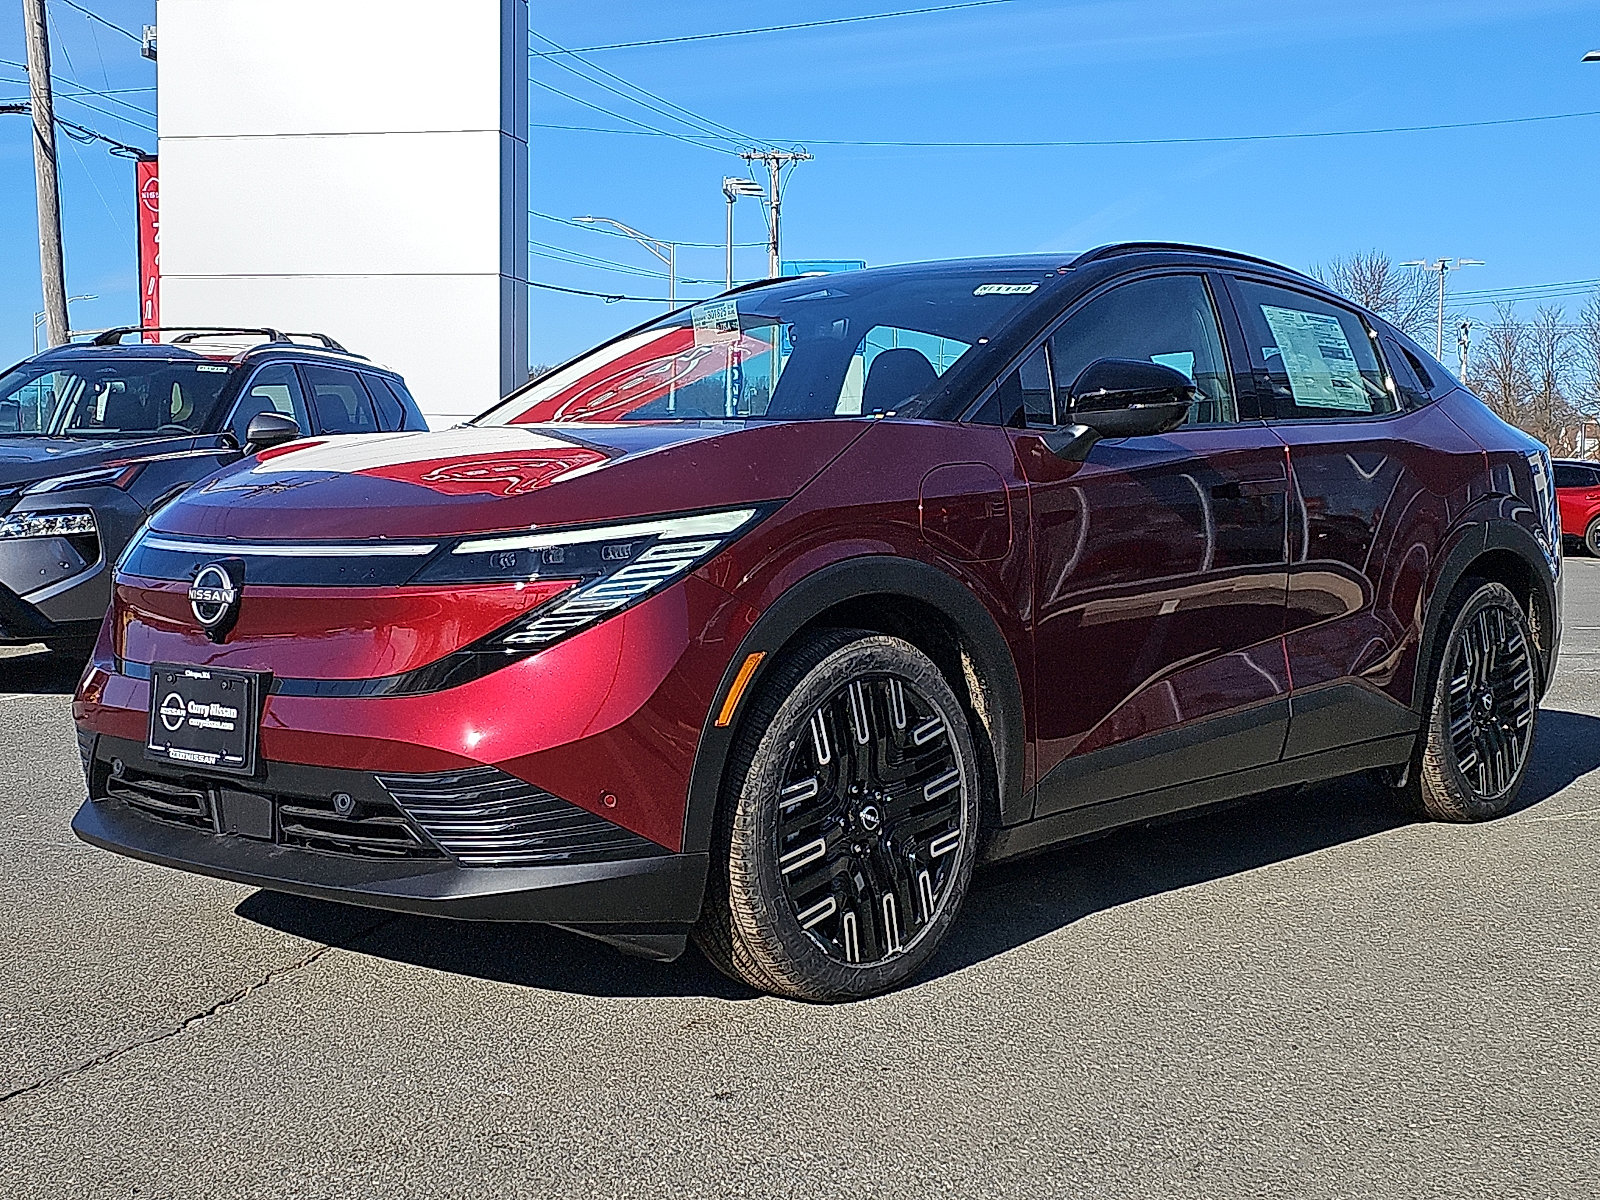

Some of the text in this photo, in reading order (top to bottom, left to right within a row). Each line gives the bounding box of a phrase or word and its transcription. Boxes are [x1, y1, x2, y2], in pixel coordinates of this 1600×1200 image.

[188, 588, 234, 603] NISSAN
[188, 701, 238, 718] Curry Nissan
